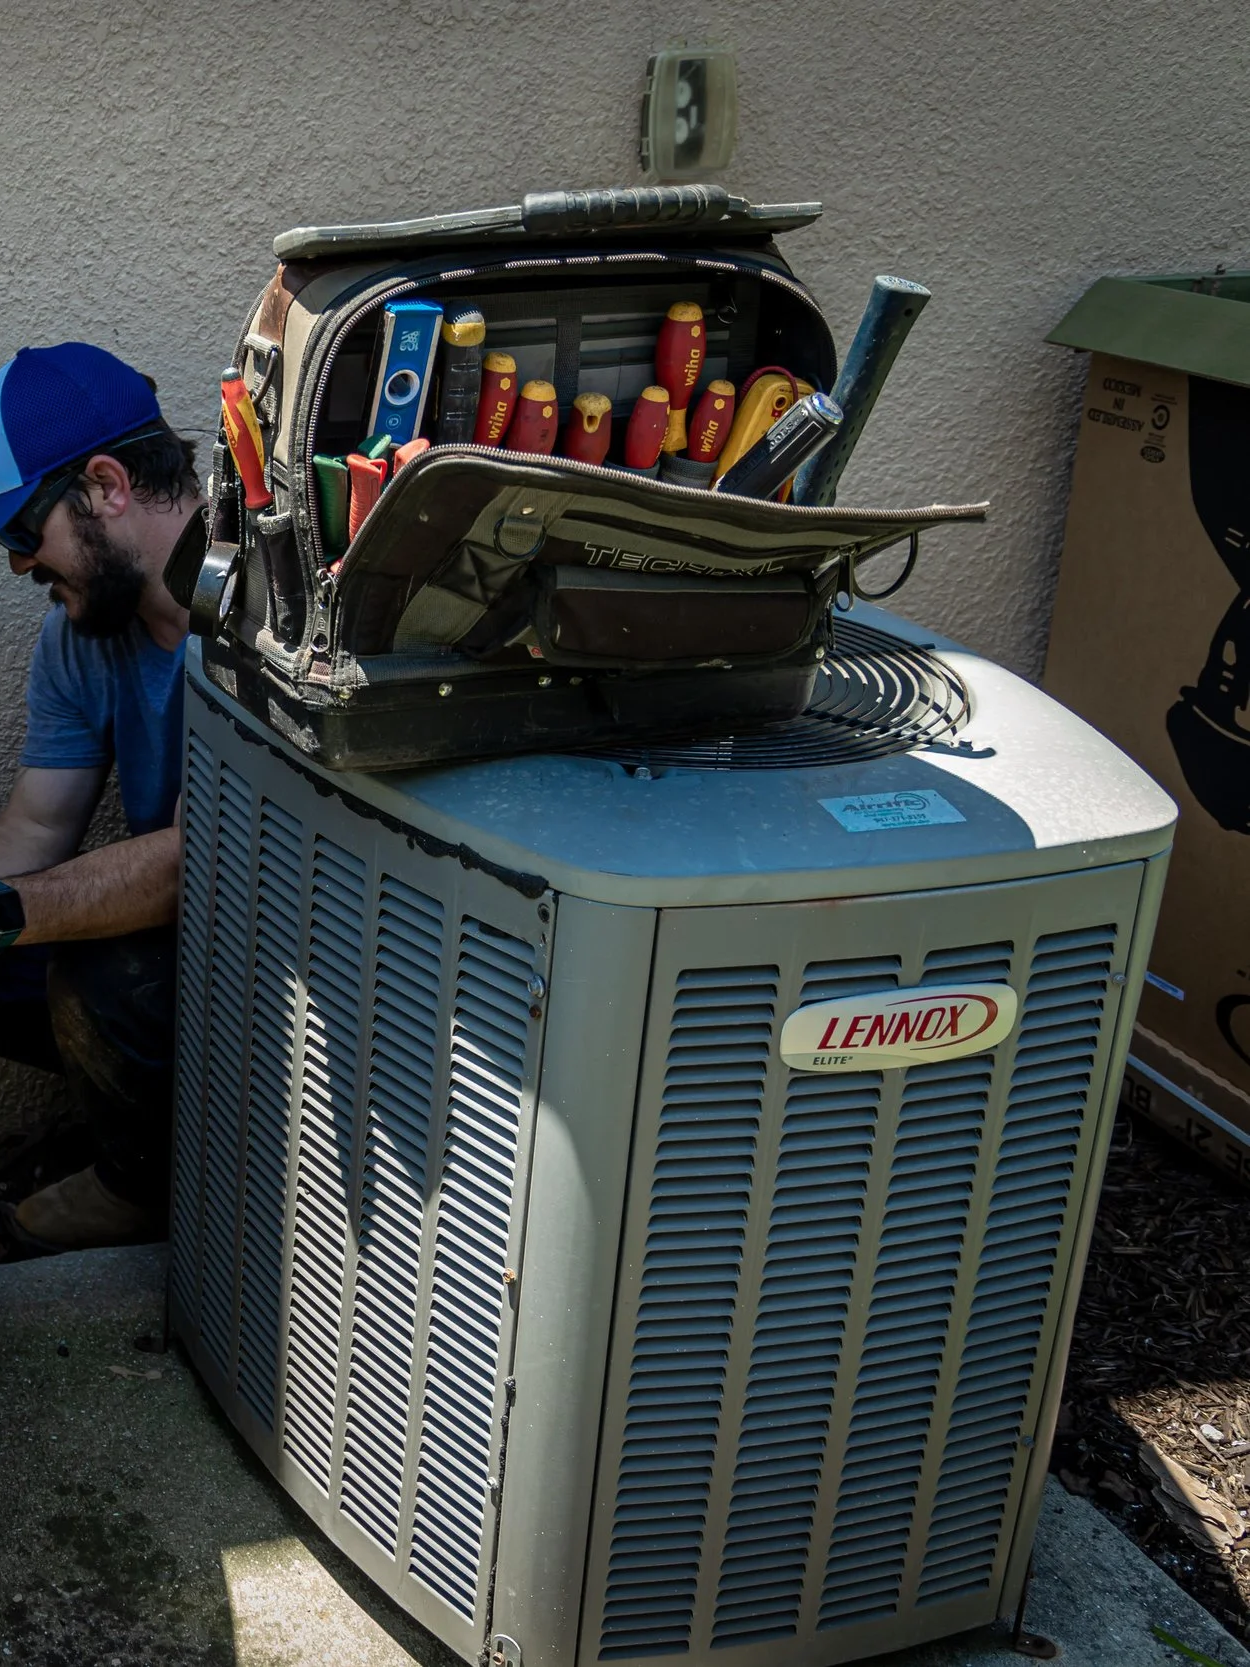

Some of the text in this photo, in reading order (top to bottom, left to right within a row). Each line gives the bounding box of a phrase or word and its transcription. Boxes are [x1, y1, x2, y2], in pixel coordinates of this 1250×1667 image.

[684, 348, 701, 387] wiha
[1103, 377, 1142, 397] MEXICO
[1112, 397, 1125, 411] IN
[488, 401, 508, 439] wiha
[700, 419, 719, 453] wiha
[1087, 408, 1145, 432] ASSEMBLED
[817, 1003, 969, 1050] LENNOX
